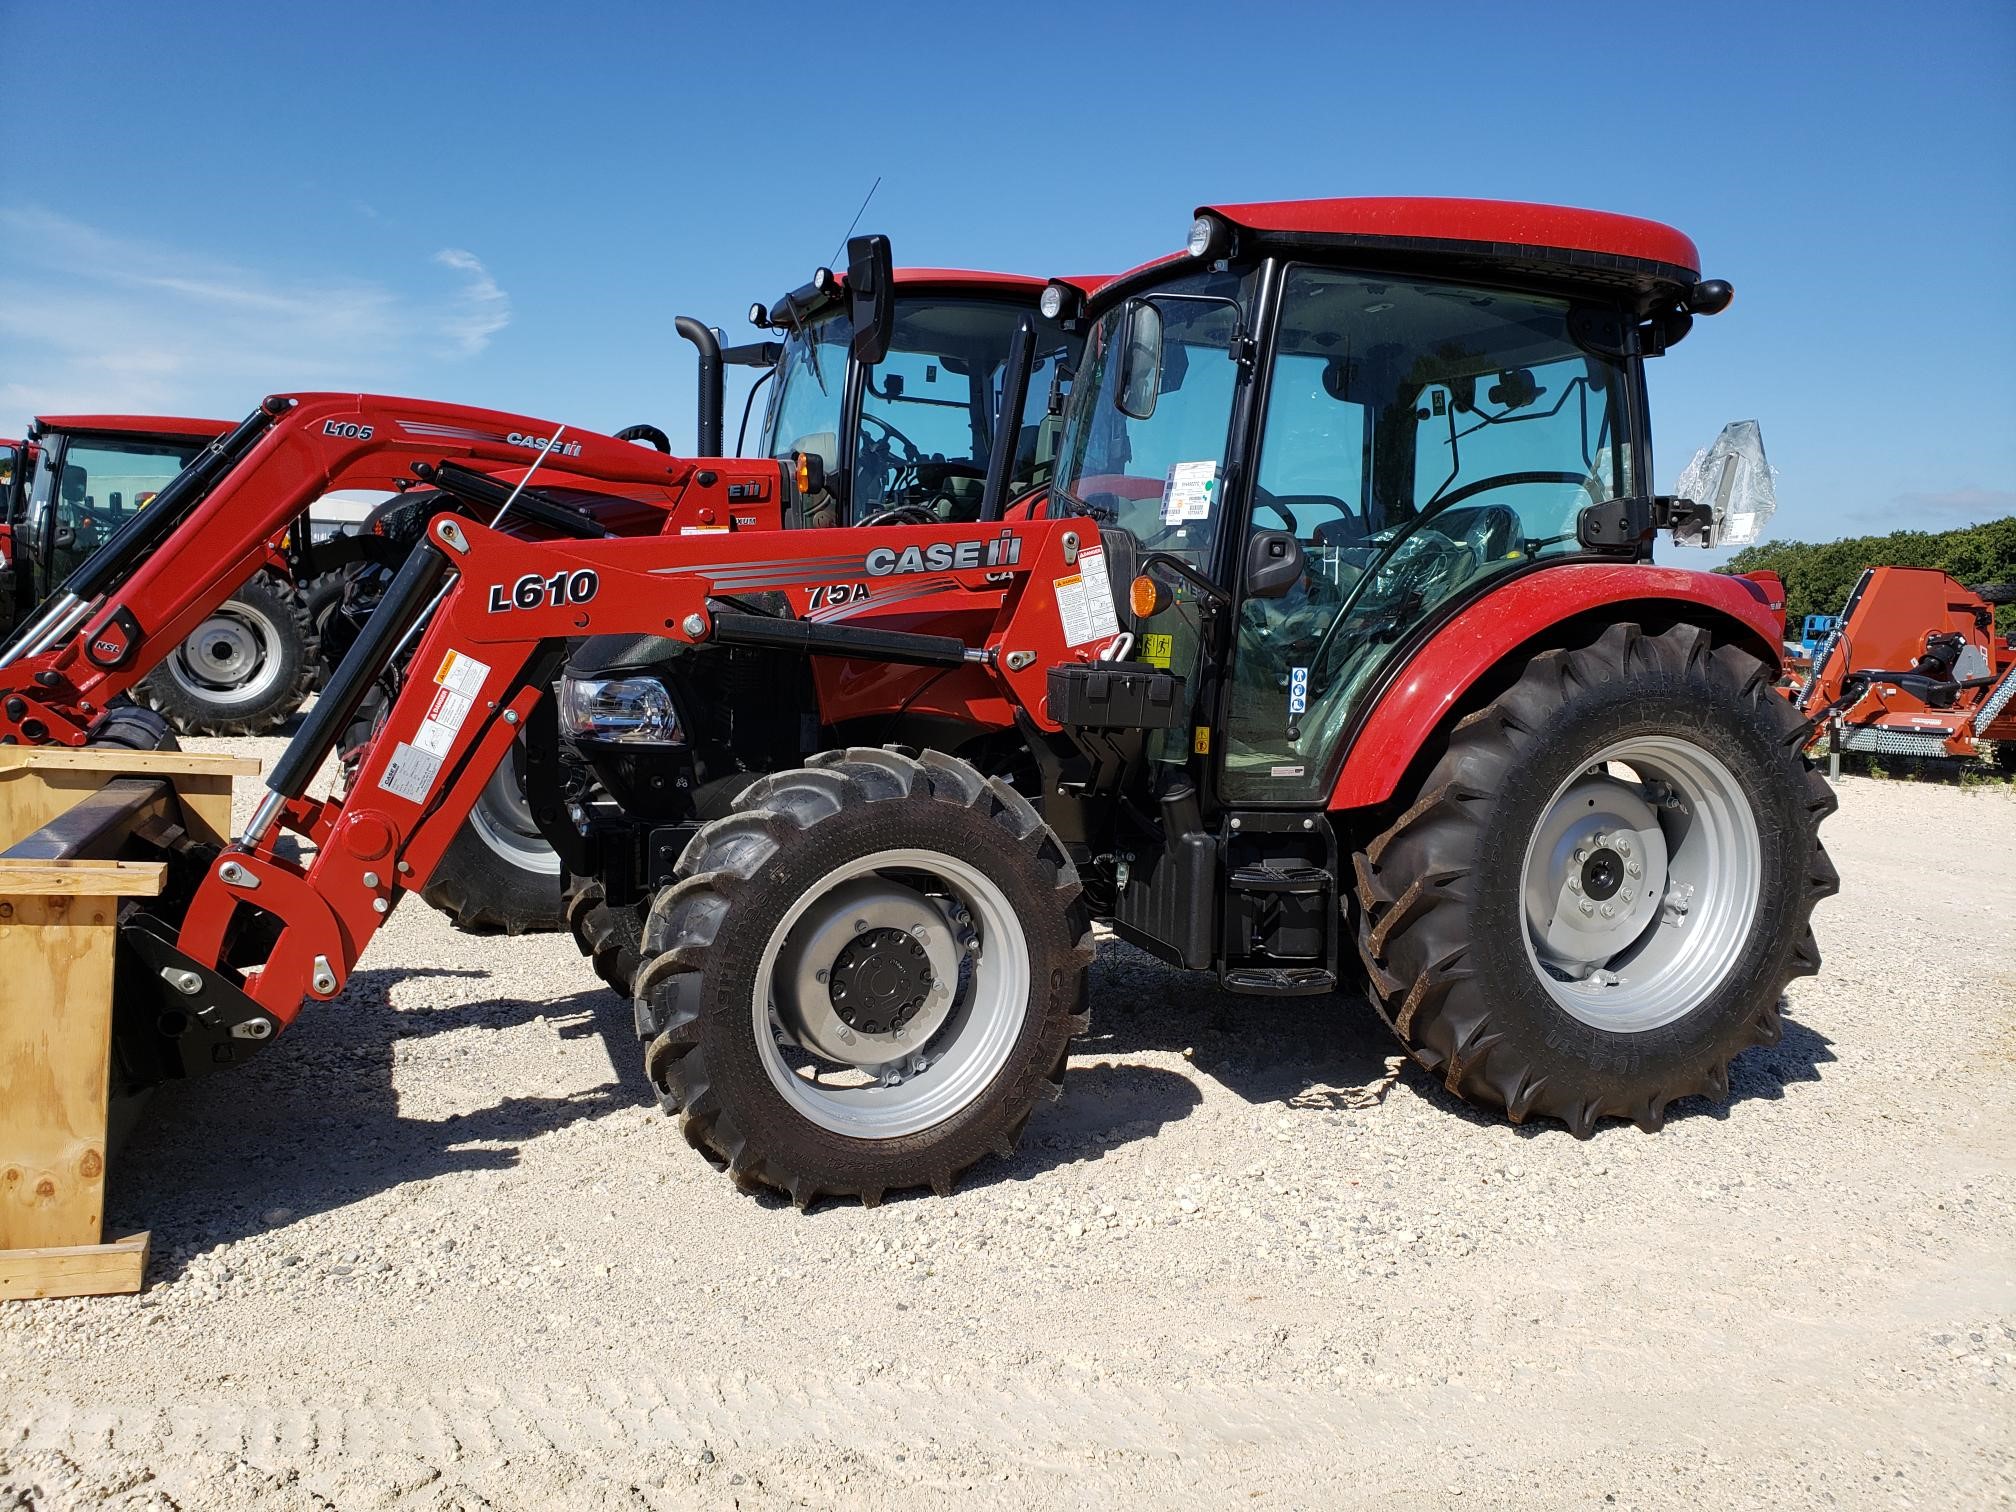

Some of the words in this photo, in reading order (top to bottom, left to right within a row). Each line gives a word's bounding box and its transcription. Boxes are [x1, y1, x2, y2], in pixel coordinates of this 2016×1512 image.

[323, 420, 374, 441] L105
[507, 432, 562, 453] CASE
[864, 540, 982, 577] CASE
[488, 569, 599, 614] L610
[804, 583, 873, 611] 75A
[95, 640, 120, 653] NSL
